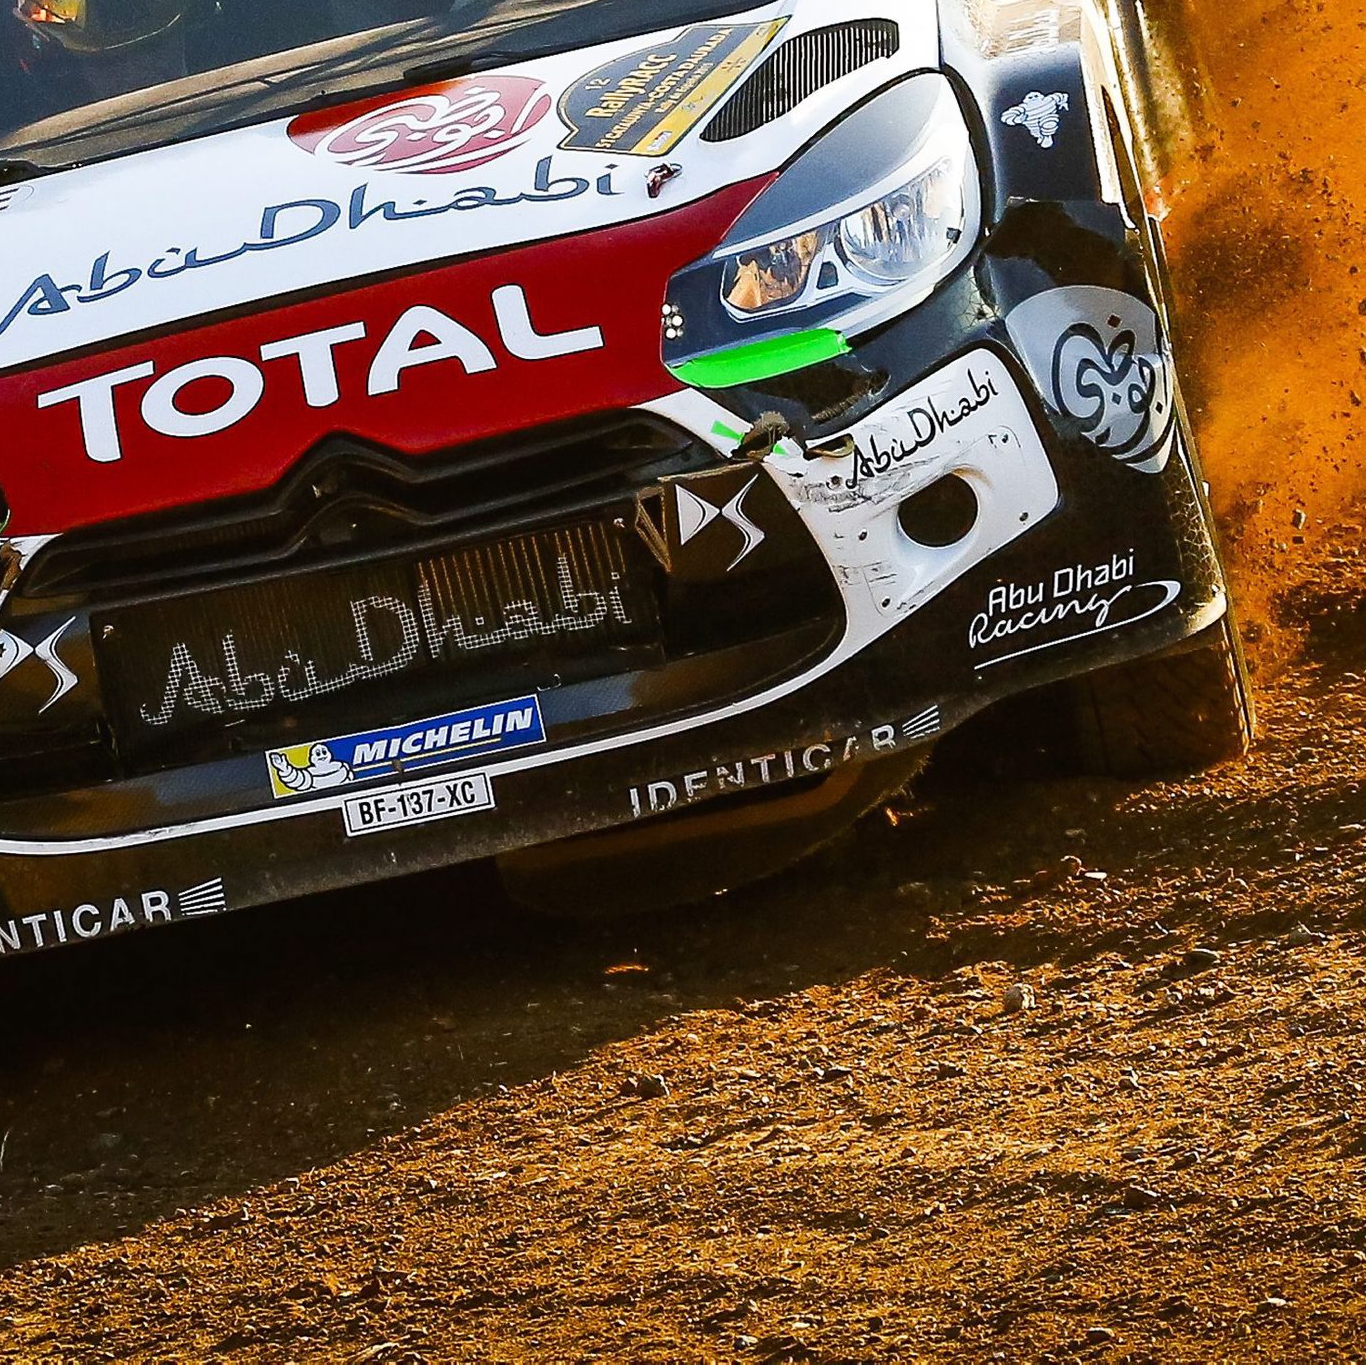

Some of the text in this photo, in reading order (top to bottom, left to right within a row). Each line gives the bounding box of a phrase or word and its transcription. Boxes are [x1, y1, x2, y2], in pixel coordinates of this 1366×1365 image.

[586, 53, 677, 118] RallyRACC
[37, 284, 604, 463] TOTAL
[988, 548, 1135, 616] Abu Dhabi
[352, 706, 535, 765] MICHELIN
[358, 780, 477, 826] BF-137-XC
